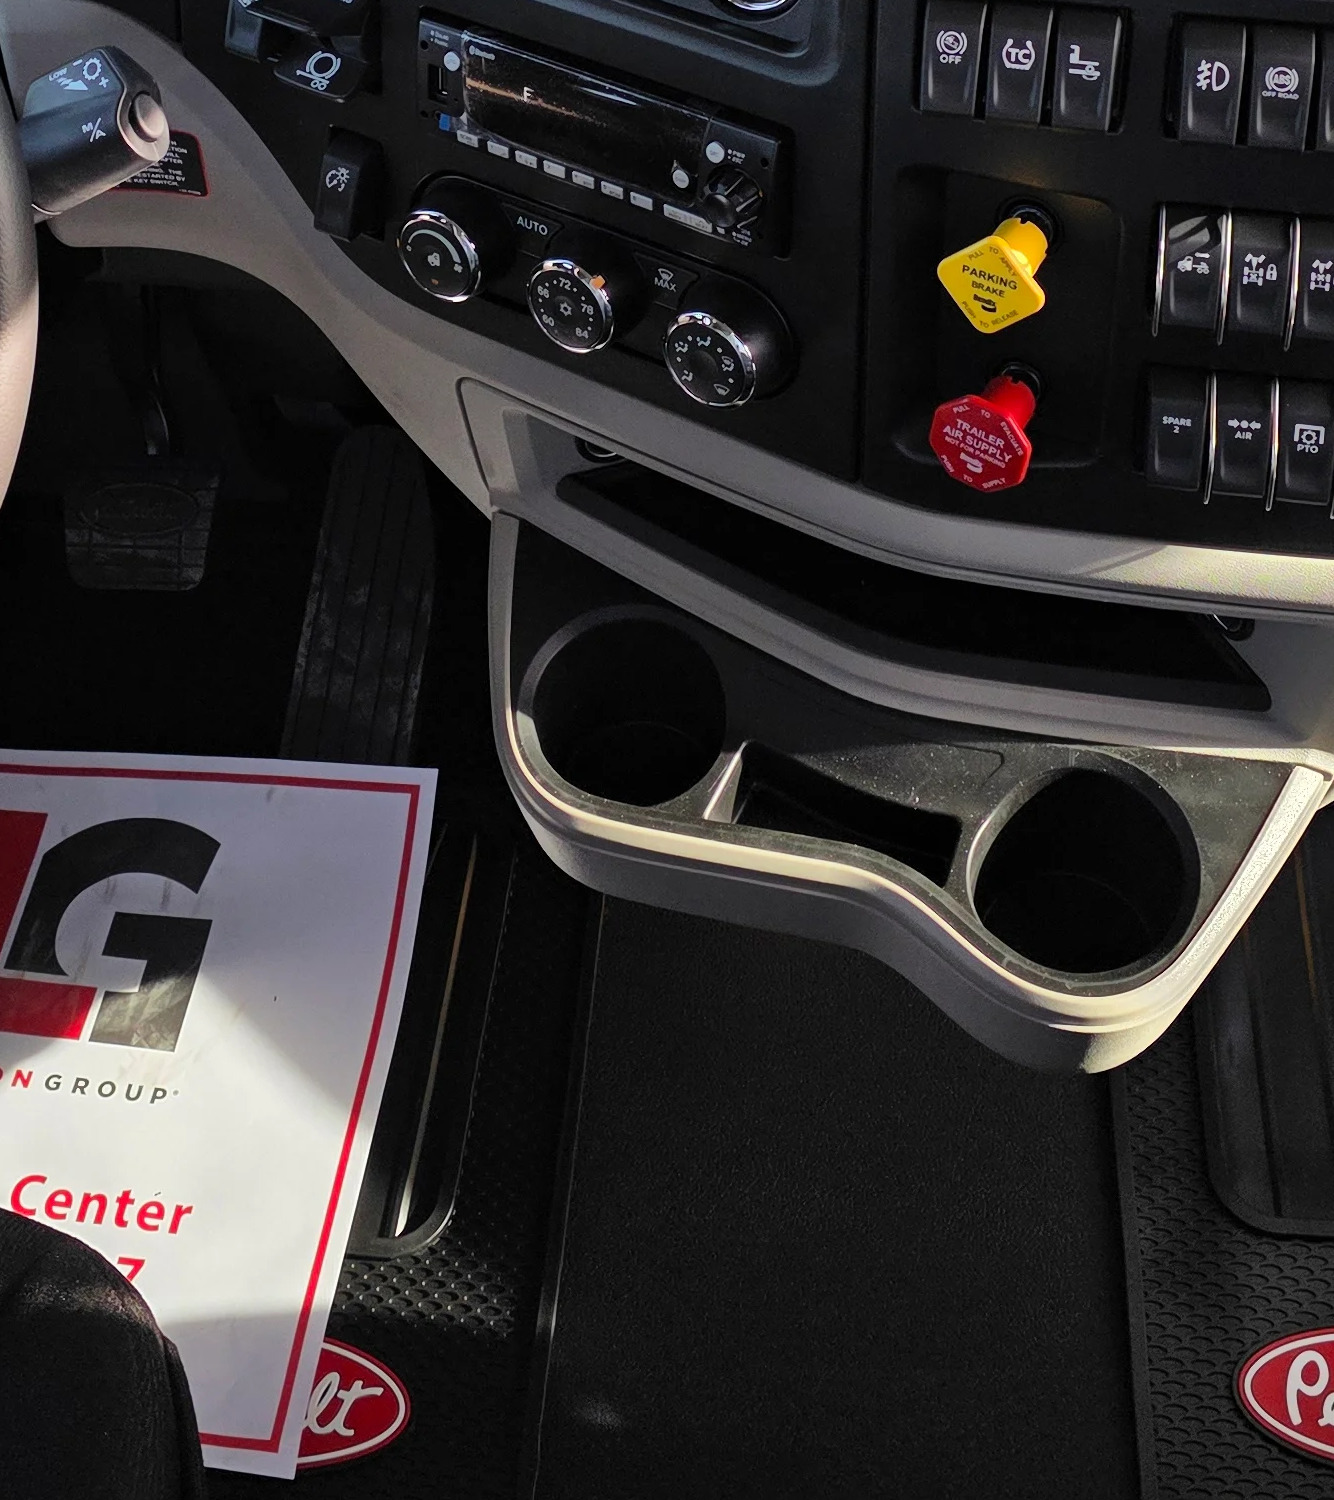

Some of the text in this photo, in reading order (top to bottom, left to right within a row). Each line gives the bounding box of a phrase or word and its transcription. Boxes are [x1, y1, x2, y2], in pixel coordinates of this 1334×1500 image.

[939, 55, 962, 64] OFF
[1008, 48, 1030, 64] TC
[48, 67, 67, 82] LOW
[1272, 74, 1291, 85] ABS
[1262, 90, 1299, 100] OFF ROAD
[517, 216, 548, 236] AUTO
[968, 249, 984, 261] PULL
[989, 246, 999, 254] TO
[962, 264, 1018, 290] PARKING
[537, 285, 550, 298] 66
[558, 278, 572, 291] 72
[654, 277, 677, 292] MAX
[971, 280, 1005, 298] BRAKE
[581, 303, 594, 315] 78
[542, 314, 555, 327] 60
[991, 309, 1018, 326] RELEASE
[575, 327, 589, 339] 84
[981, 409, 991, 418] TO
[1162, 416, 1192, 426] SPARE
[956, 418, 1005, 449] TRAILER
[1173, 425, 1179, 434] 2
[1234, 431, 1252, 440] AIR
[943, 425, 963, 440] AIR
[965, 435, 1012, 463] SUPPLY
[1297, 443, 1319, 454] PTO
[944, 436, 959, 447] NOT
[975, 450, 1006, 469] PARKING
[44, 1073, 169, 1104] GROUP
[10, 1174, 194, 1235] Center
